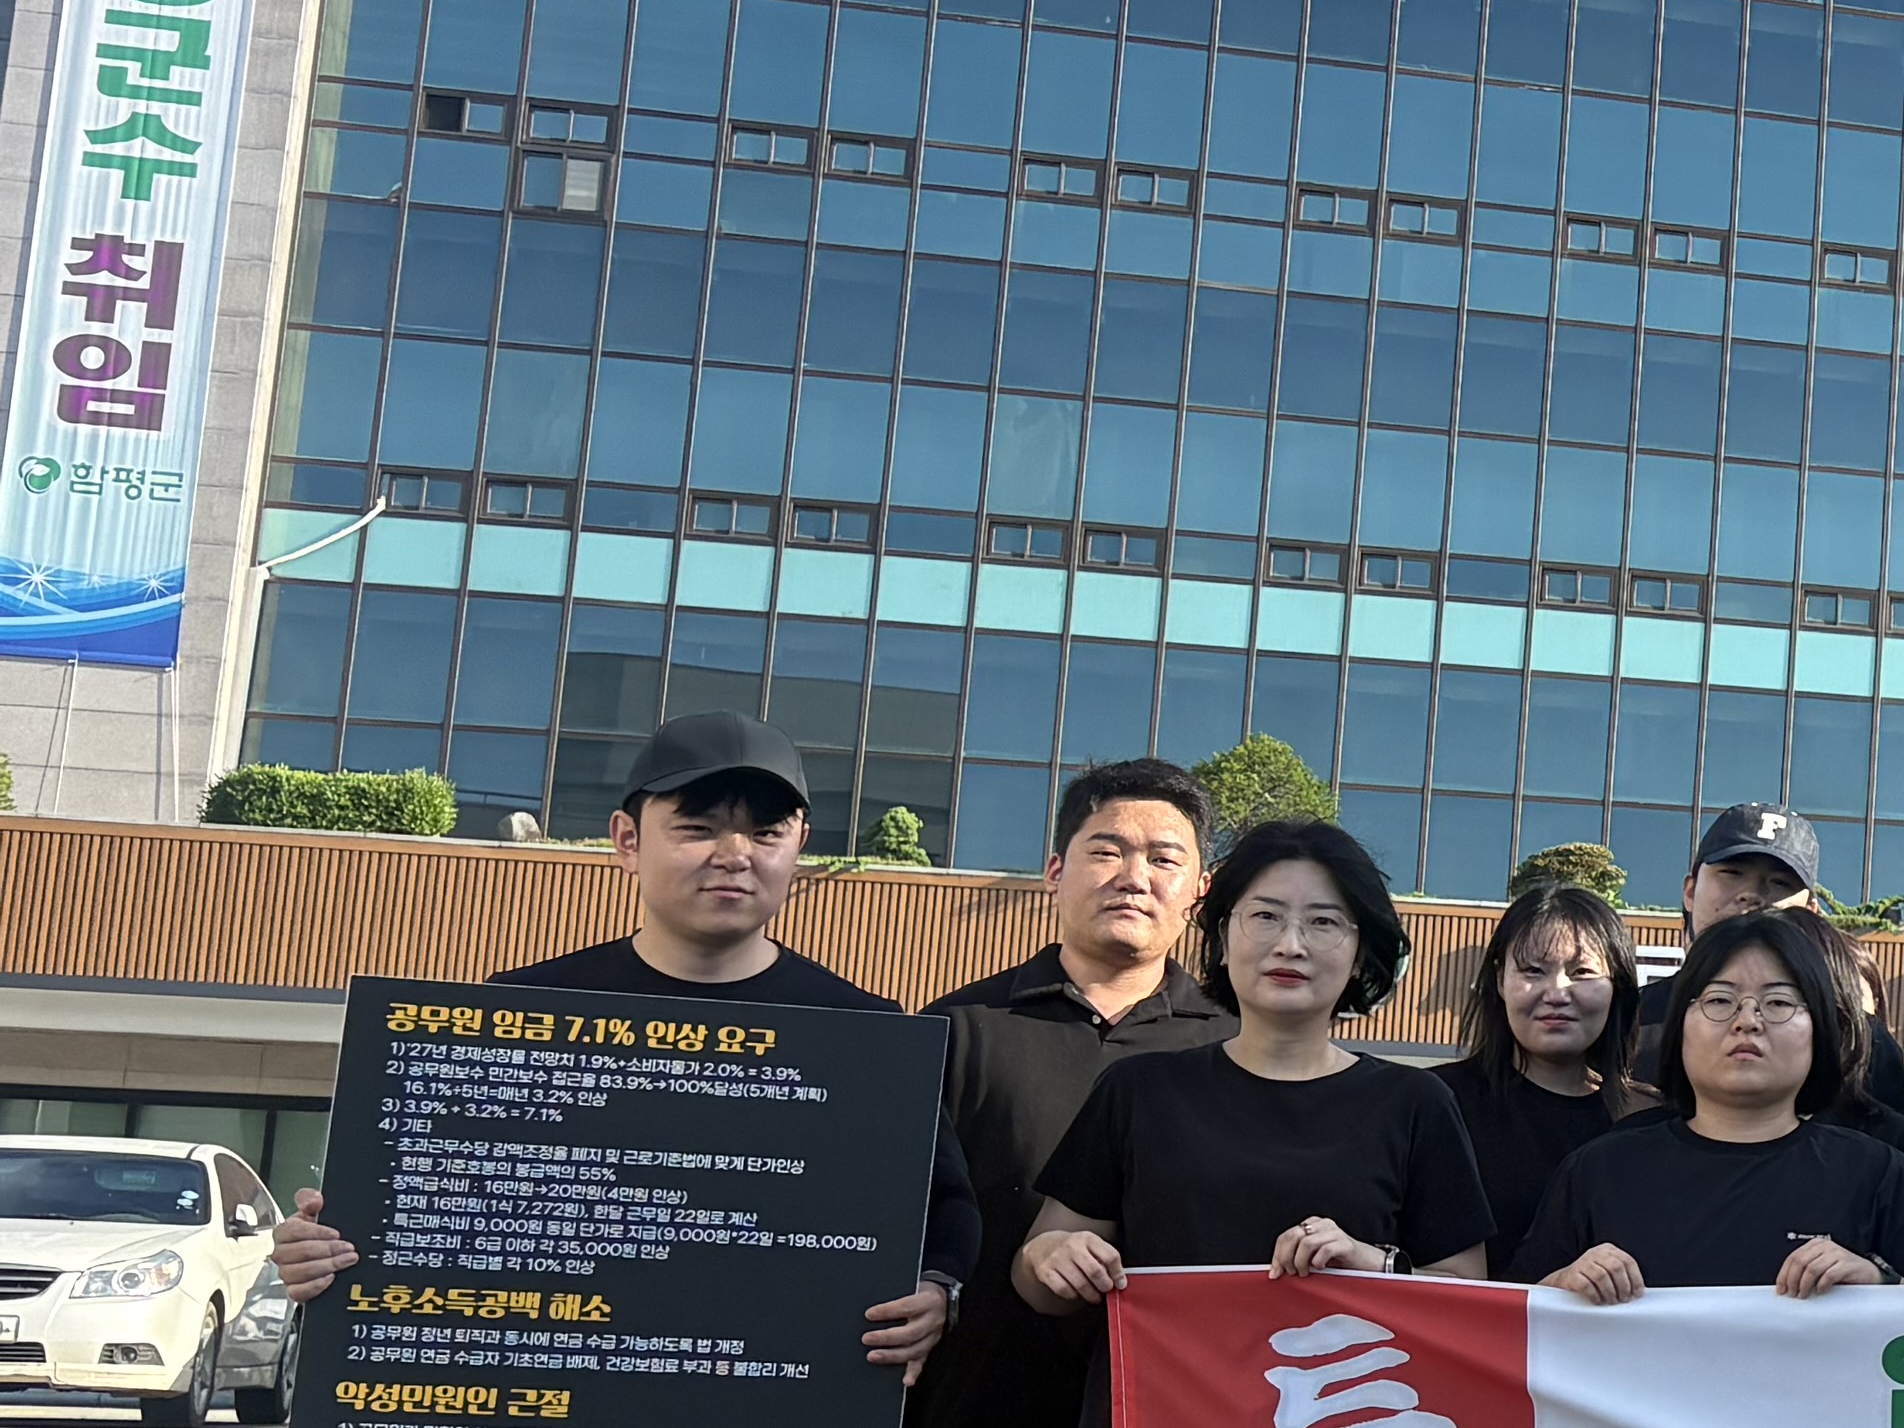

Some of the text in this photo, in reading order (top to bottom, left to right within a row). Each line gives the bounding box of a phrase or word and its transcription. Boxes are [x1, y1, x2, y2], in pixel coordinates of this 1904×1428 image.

[52, 232, 185, 432] 취임
[69, 458, 185, 503] 함평군
[1757, 812, 1787, 840] F
[385, 1002, 776, 1056] 공무원 임금 7.1% 인상 요구
[396, 1194, 758, 1227] 현재 16만원(1식 7,272원), 한달 근무일 22일로 계산
[346, 1284, 611, 1322] 노후소득공백 해소
[352, 1324, 745, 1355] 1) 공무원 정년 퇴직과 동시에 연금 수급 가능하도록 법 개정
[335, 1381, 571, 1418] 악성민원인 근절
